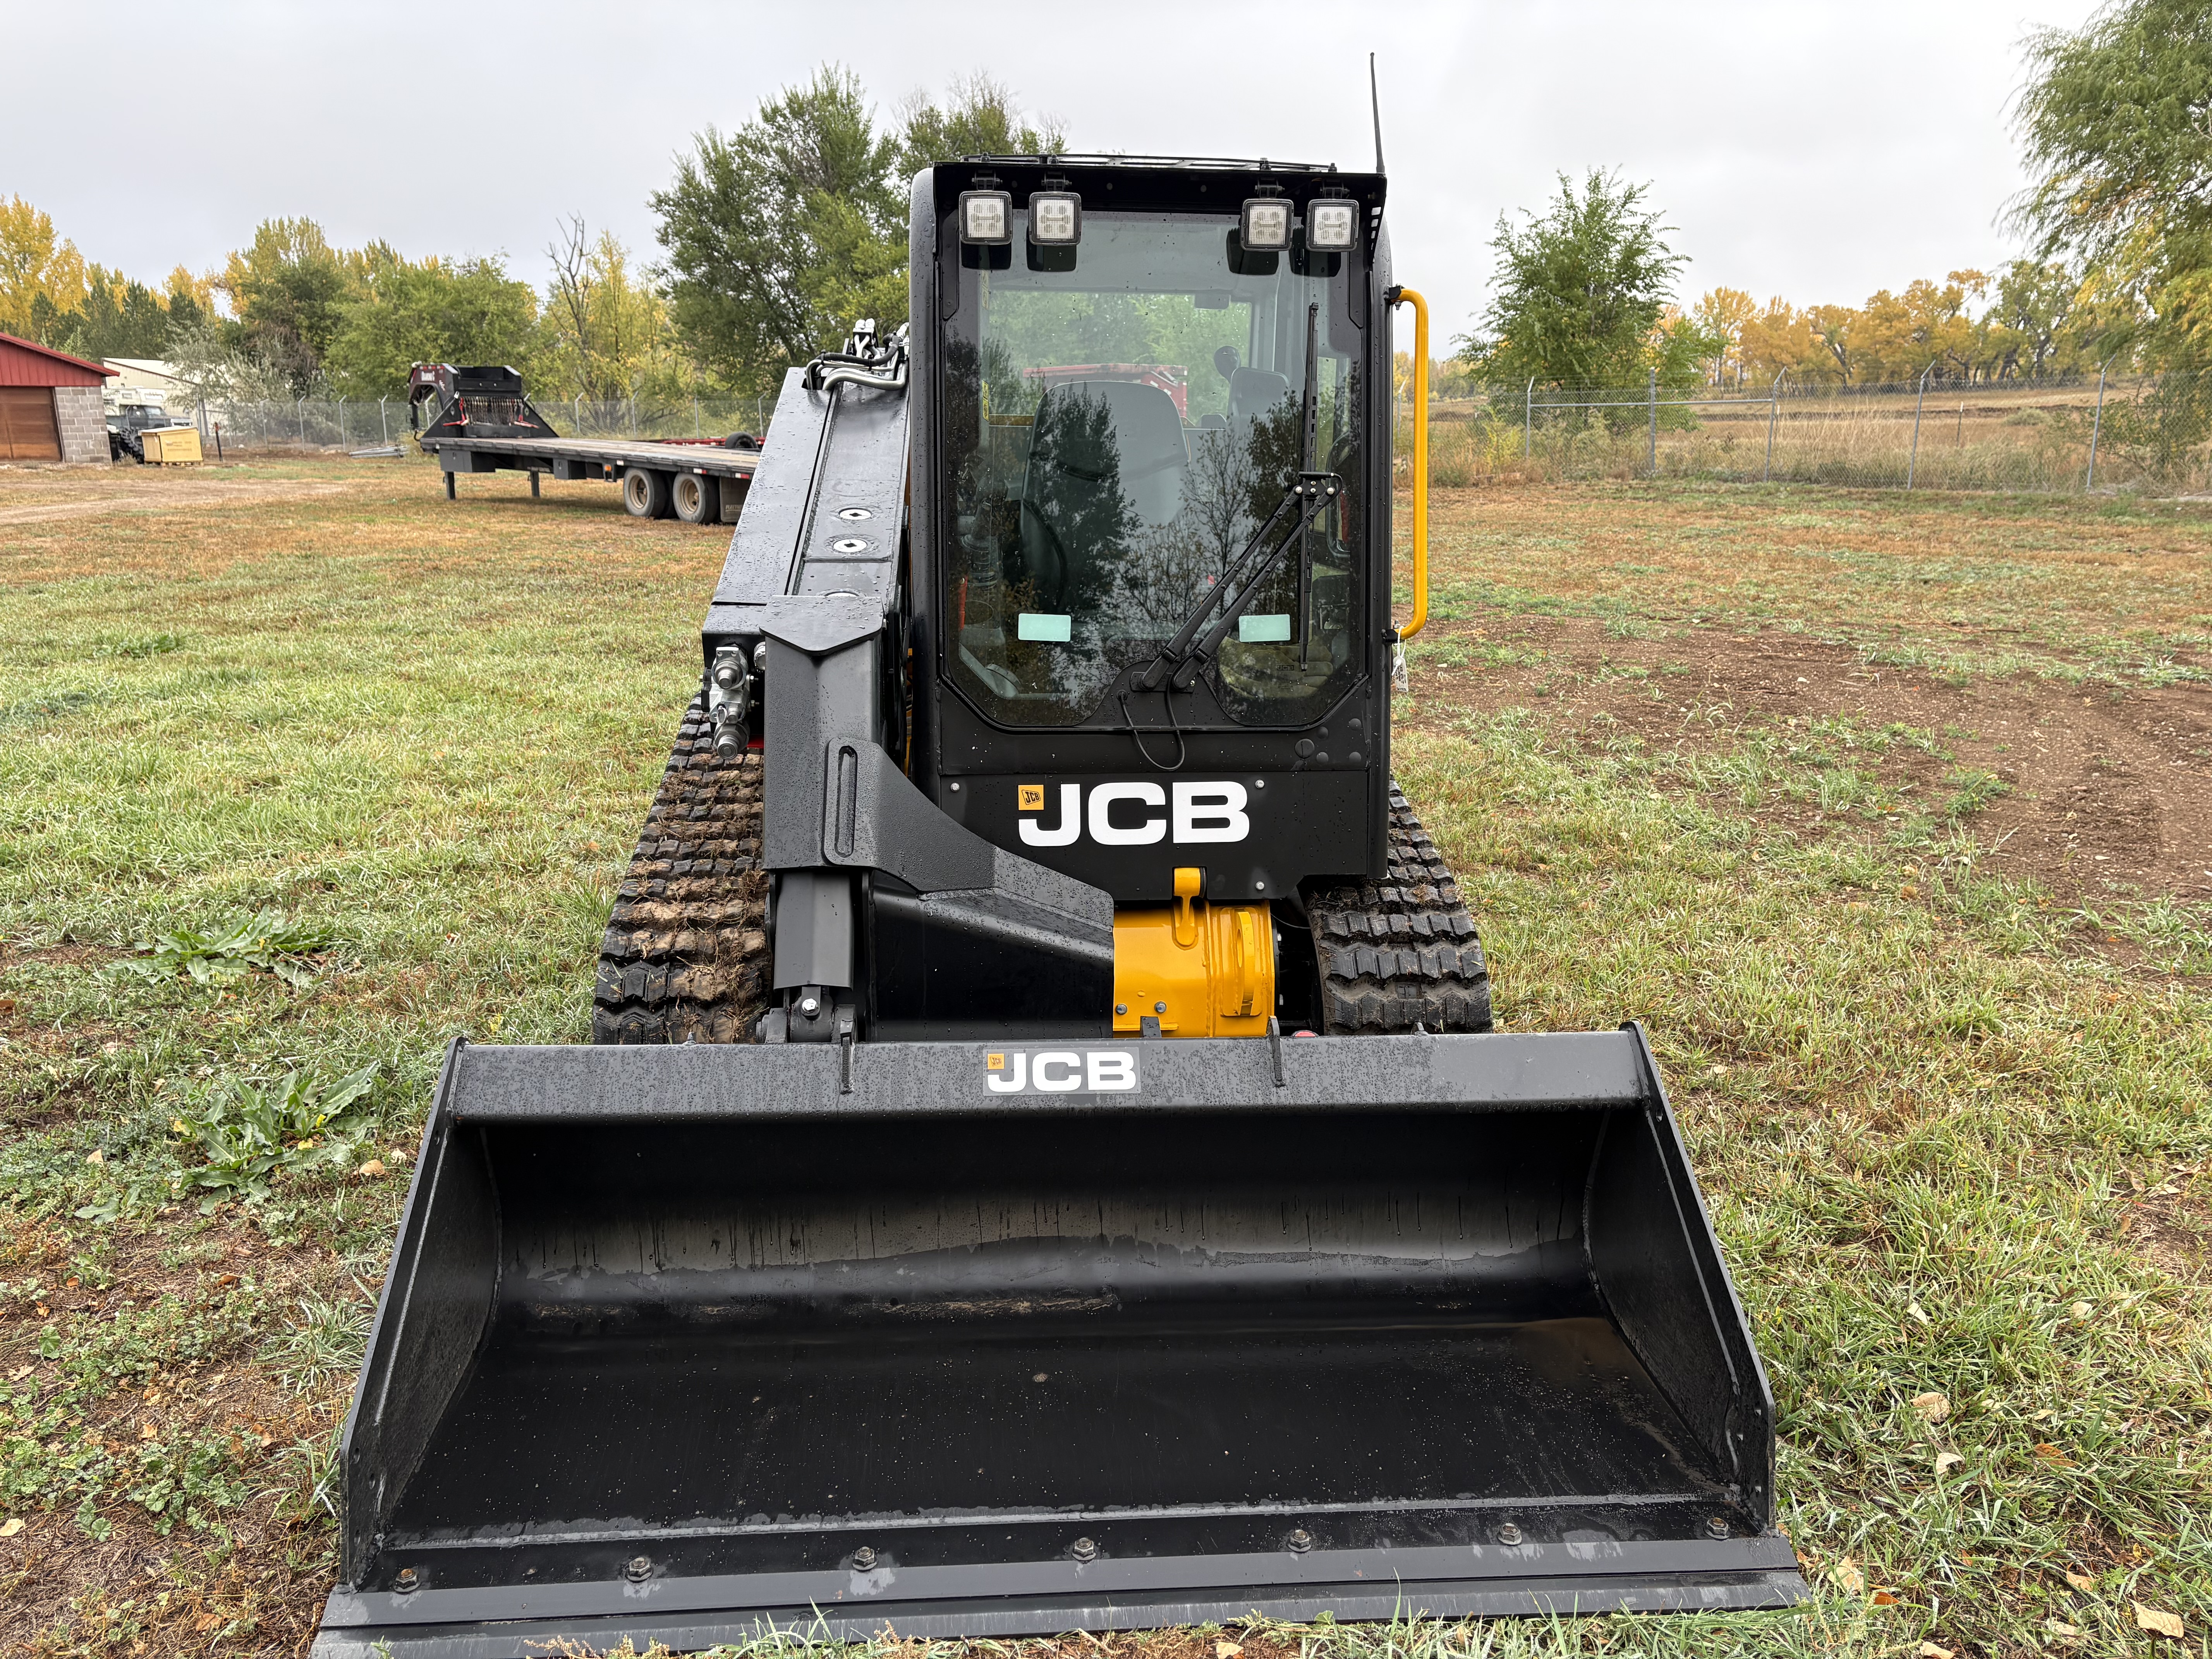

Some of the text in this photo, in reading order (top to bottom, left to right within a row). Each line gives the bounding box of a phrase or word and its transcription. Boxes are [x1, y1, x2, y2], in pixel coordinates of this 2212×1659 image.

[1018, 781, 1250, 847] JCB
[1025, 791, 1039, 803] JCB
[988, 1051, 1136, 1092] JCB
